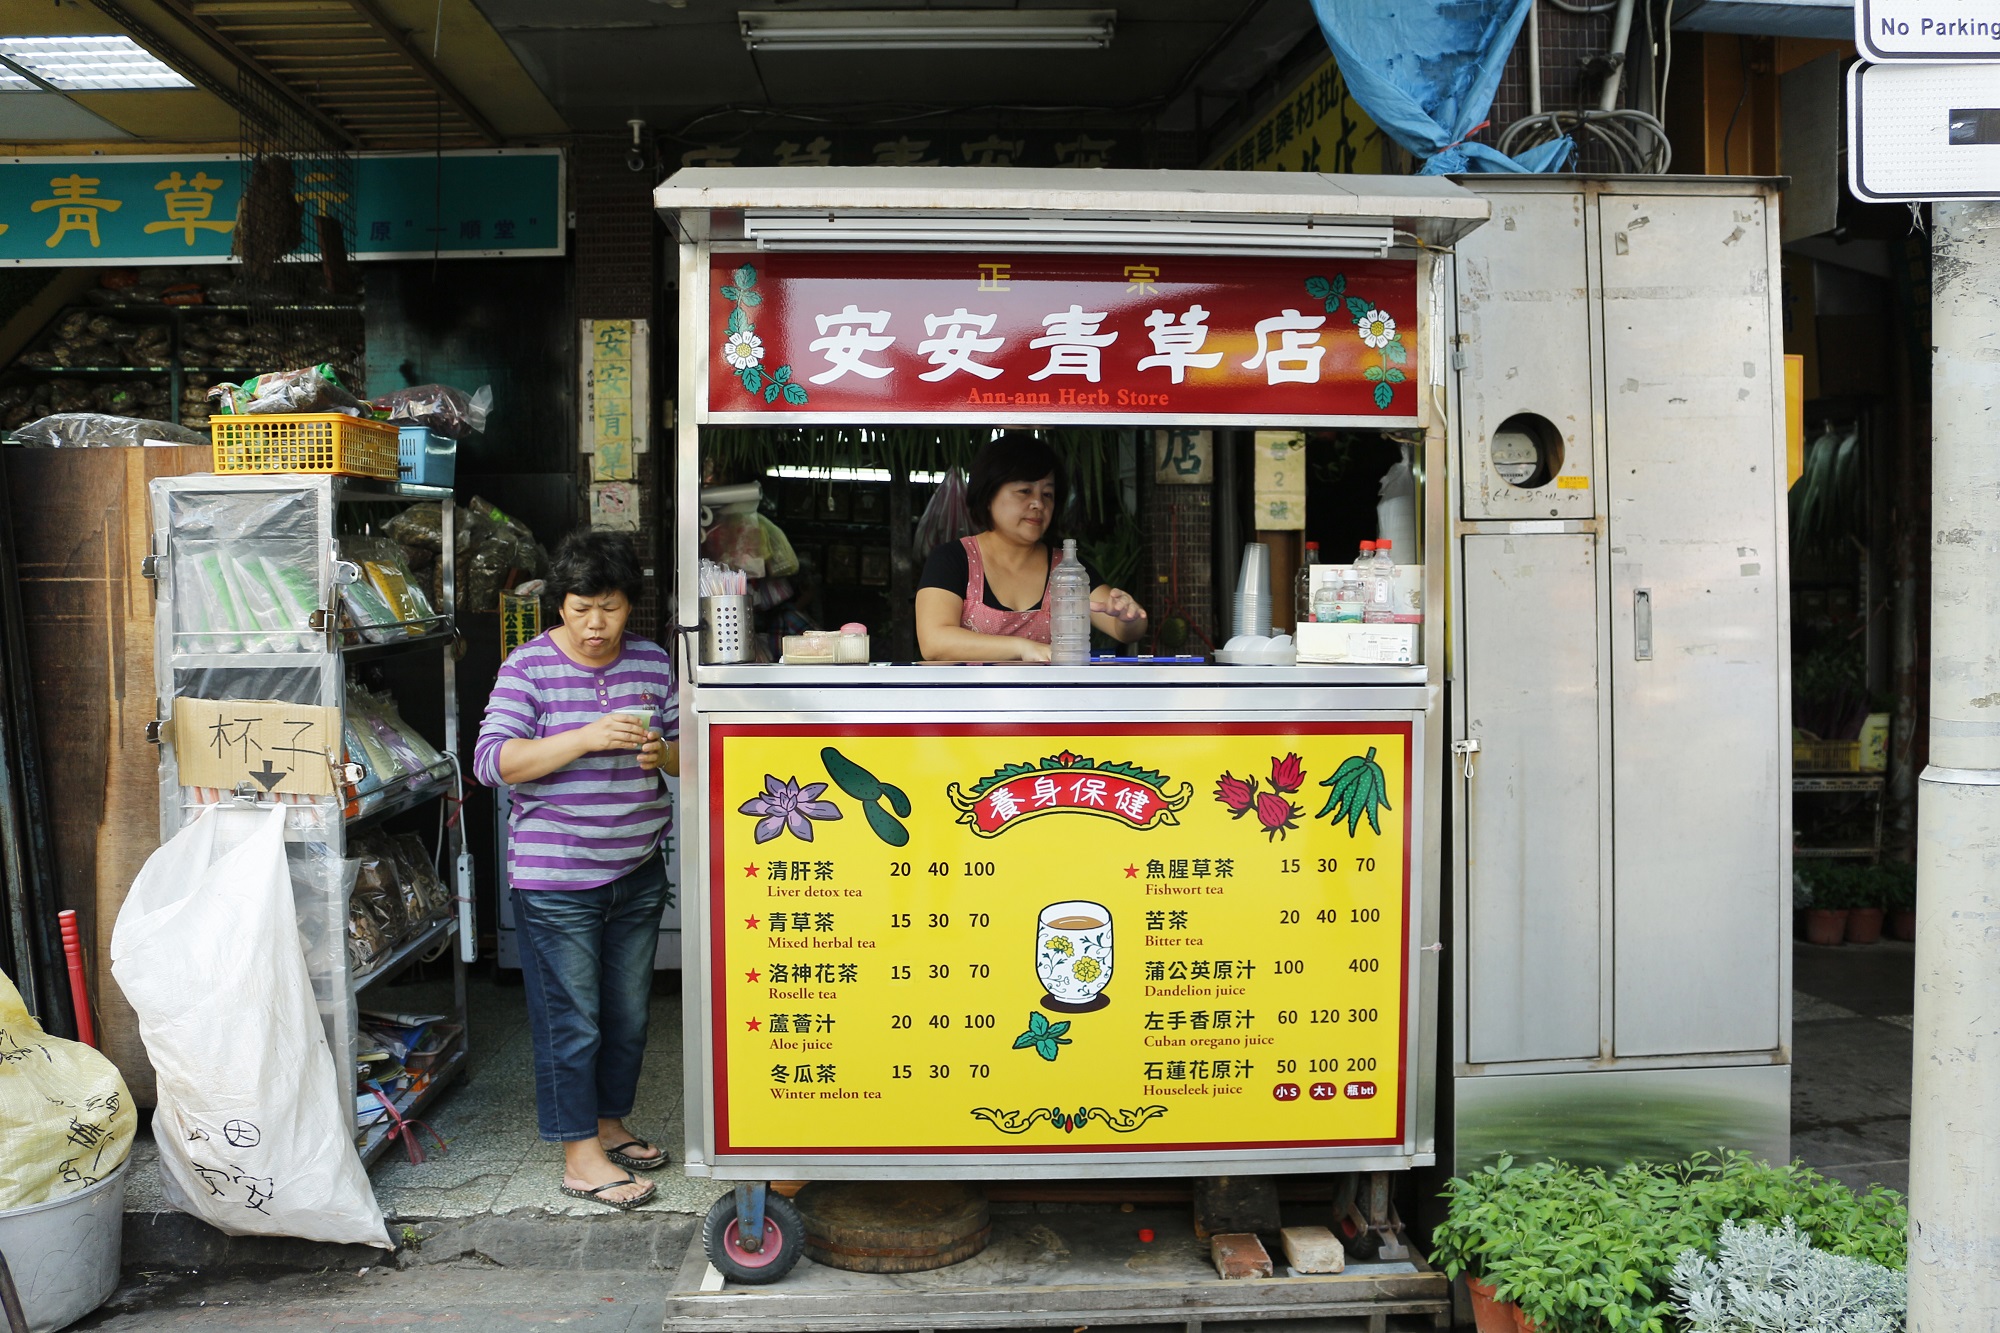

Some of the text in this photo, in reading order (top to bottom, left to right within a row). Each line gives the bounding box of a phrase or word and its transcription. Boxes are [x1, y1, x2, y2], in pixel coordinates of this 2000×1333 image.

[1881, 17, 2000, 41] No Parking
[808, 304, 1327, 386] 安安青草店
[596, 325, 628, 476] 安安青草
[967, 388, 1169, 406] Ann-ann Herb Store
[505, 599, 518, 657] 蒲公英
[208, 713, 327, 772] 杯子
[989, 775, 1150, 822] 養身保健
[767, 861, 995, 881] 清肝茶 20 40 100
[1146, 858, 1375, 879] 魚腥草茶 15 30 70
[768, 886, 862, 897] Liver detox tea
[1146, 884, 1201, 895] Fishwort
[768, 912, 989, 932] 青草茶 15 30 70
[1146, 908, 1380, 930] 苦茶 20 40 100
[769, 937, 875, 948] Mixed herbal tea
[1146, 935, 1181, 946] Bitter
[769, 963, 989, 983] 洛神花茶 15 30 70
[1145, 958, 1379, 981] 蒲公英原汁 100 400
[769, 988, 836, 999] Roselle tea
[1145, 985, 1245, 998] Dandelion juice
[769, 1014, 995, 1033] 蘆薈汁 20 40 100
[1144, 1008, 1378, 1030] 左手香原汁 60 120 300
[770, 1038, 832, 1052] Aloe juice
[1144, 1035, 1274, 1049] Cuban oregano juice
[771, 1064, 989, 1083] 冬瓜茶 15 30 70
[1144, 1058, 1376, 1080] 石蓮花原汁 50 100 200
[770, 1089, 815, 1099] Winter
[820, 1088, 858, 1099] melon
[1144, 1084, 1242, 1097] Houseleek juice
[1276, 1086, 1288, 1098] 小
[1313, 1085, 1326, 1097] 大
[1347, 1085, 1359, 1096] 瓶
[1361, 1086, 1374, 1095] btl
